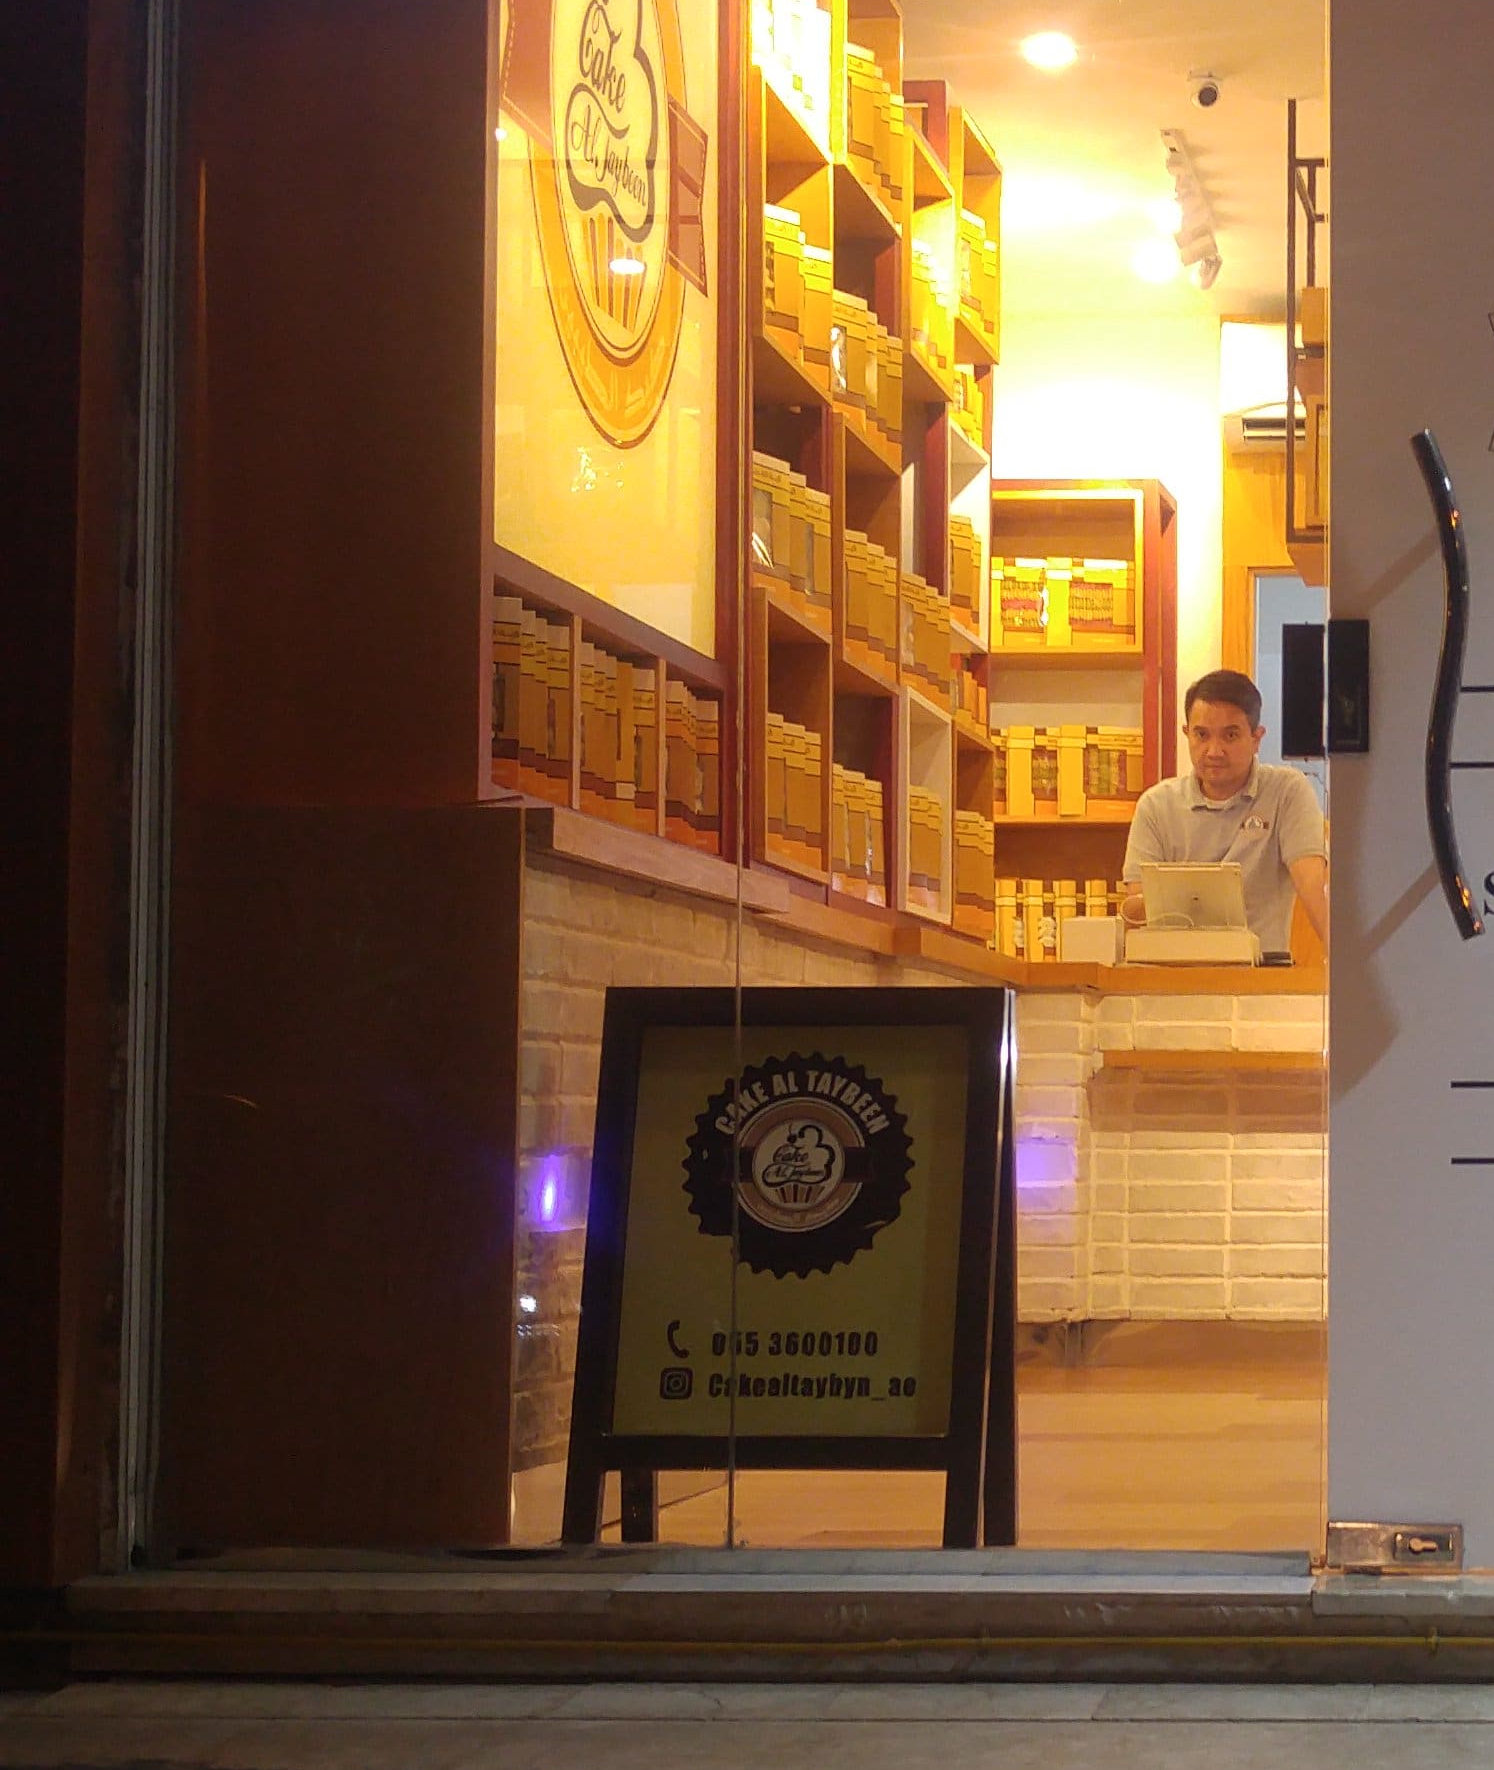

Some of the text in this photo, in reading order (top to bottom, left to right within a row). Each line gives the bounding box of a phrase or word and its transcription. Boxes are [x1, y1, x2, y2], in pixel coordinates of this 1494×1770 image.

[714, 1069, 891, 1135] CAKE AL TAYBEEN
[768, 1330, 879, 1357] 3600100
